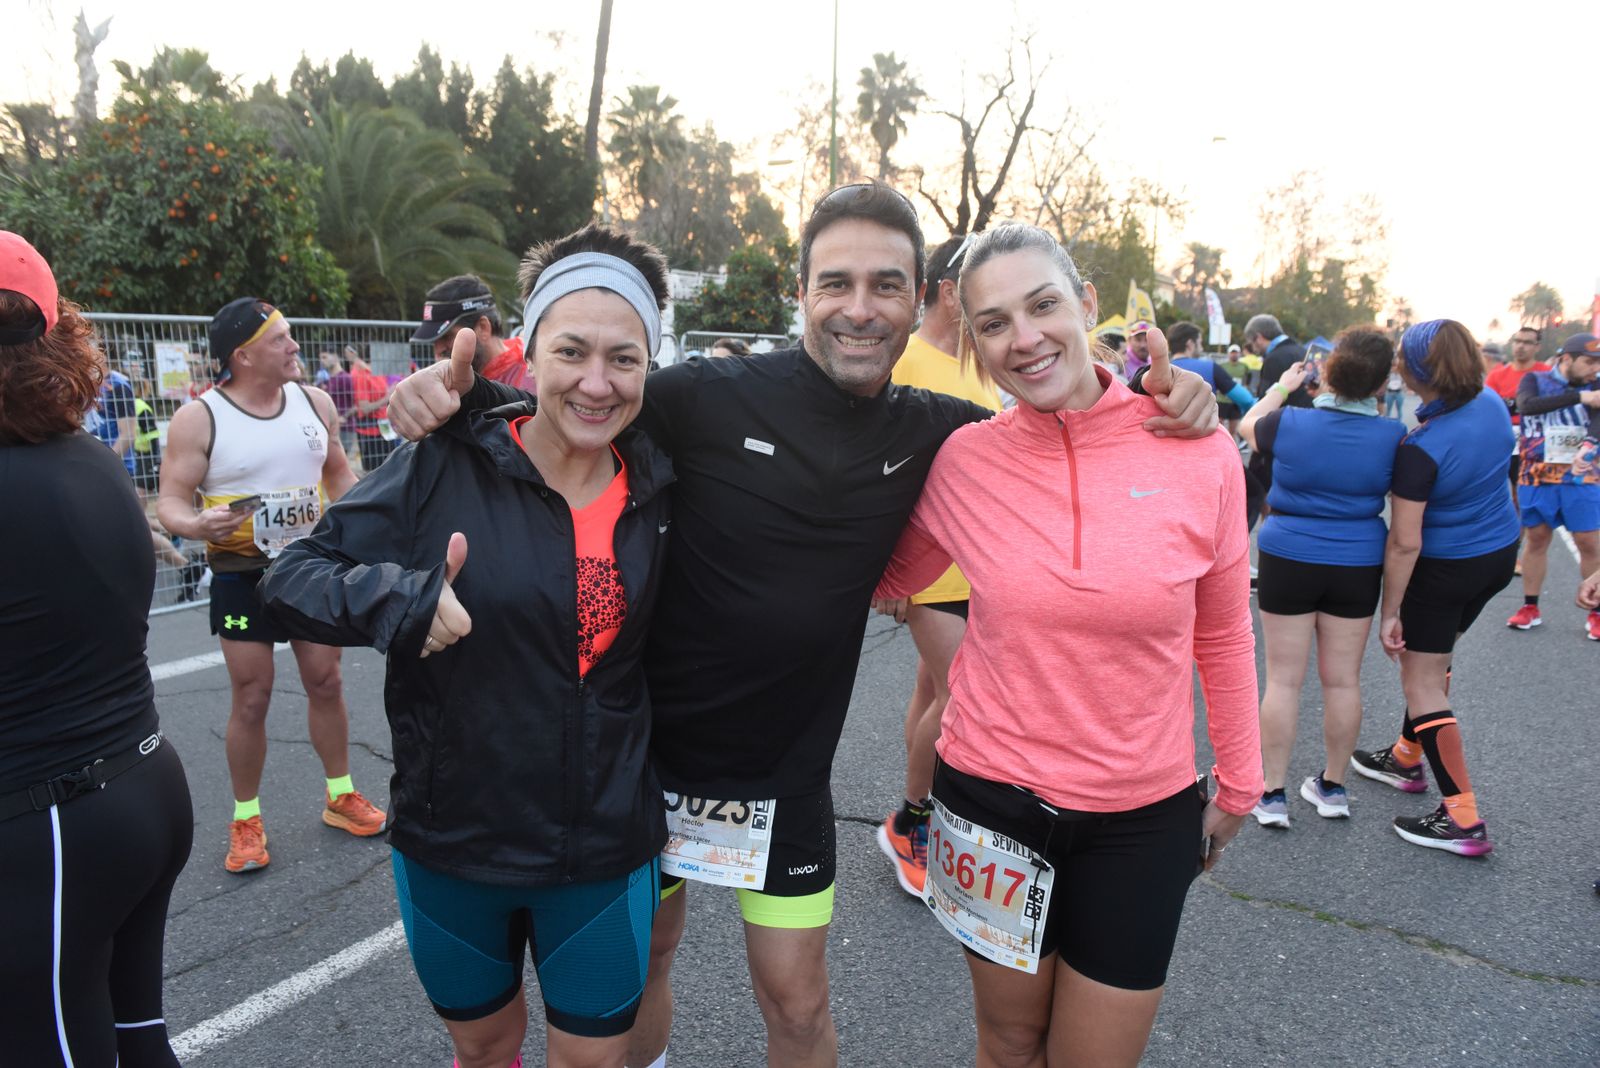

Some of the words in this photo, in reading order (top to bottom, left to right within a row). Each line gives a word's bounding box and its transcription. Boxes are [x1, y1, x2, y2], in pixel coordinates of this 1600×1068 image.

[261, 502, 315, 528] 14516
[943, 811, 973, 835] MARATON
[992, 832, 1035, 860] SEVILLA
[678, 861, 700, 873] HOKA
[789, 863, 819, 875] LIXADA
[932, 828, 1027, 908] 13617
[955, 927, 973, 943] HOKA
